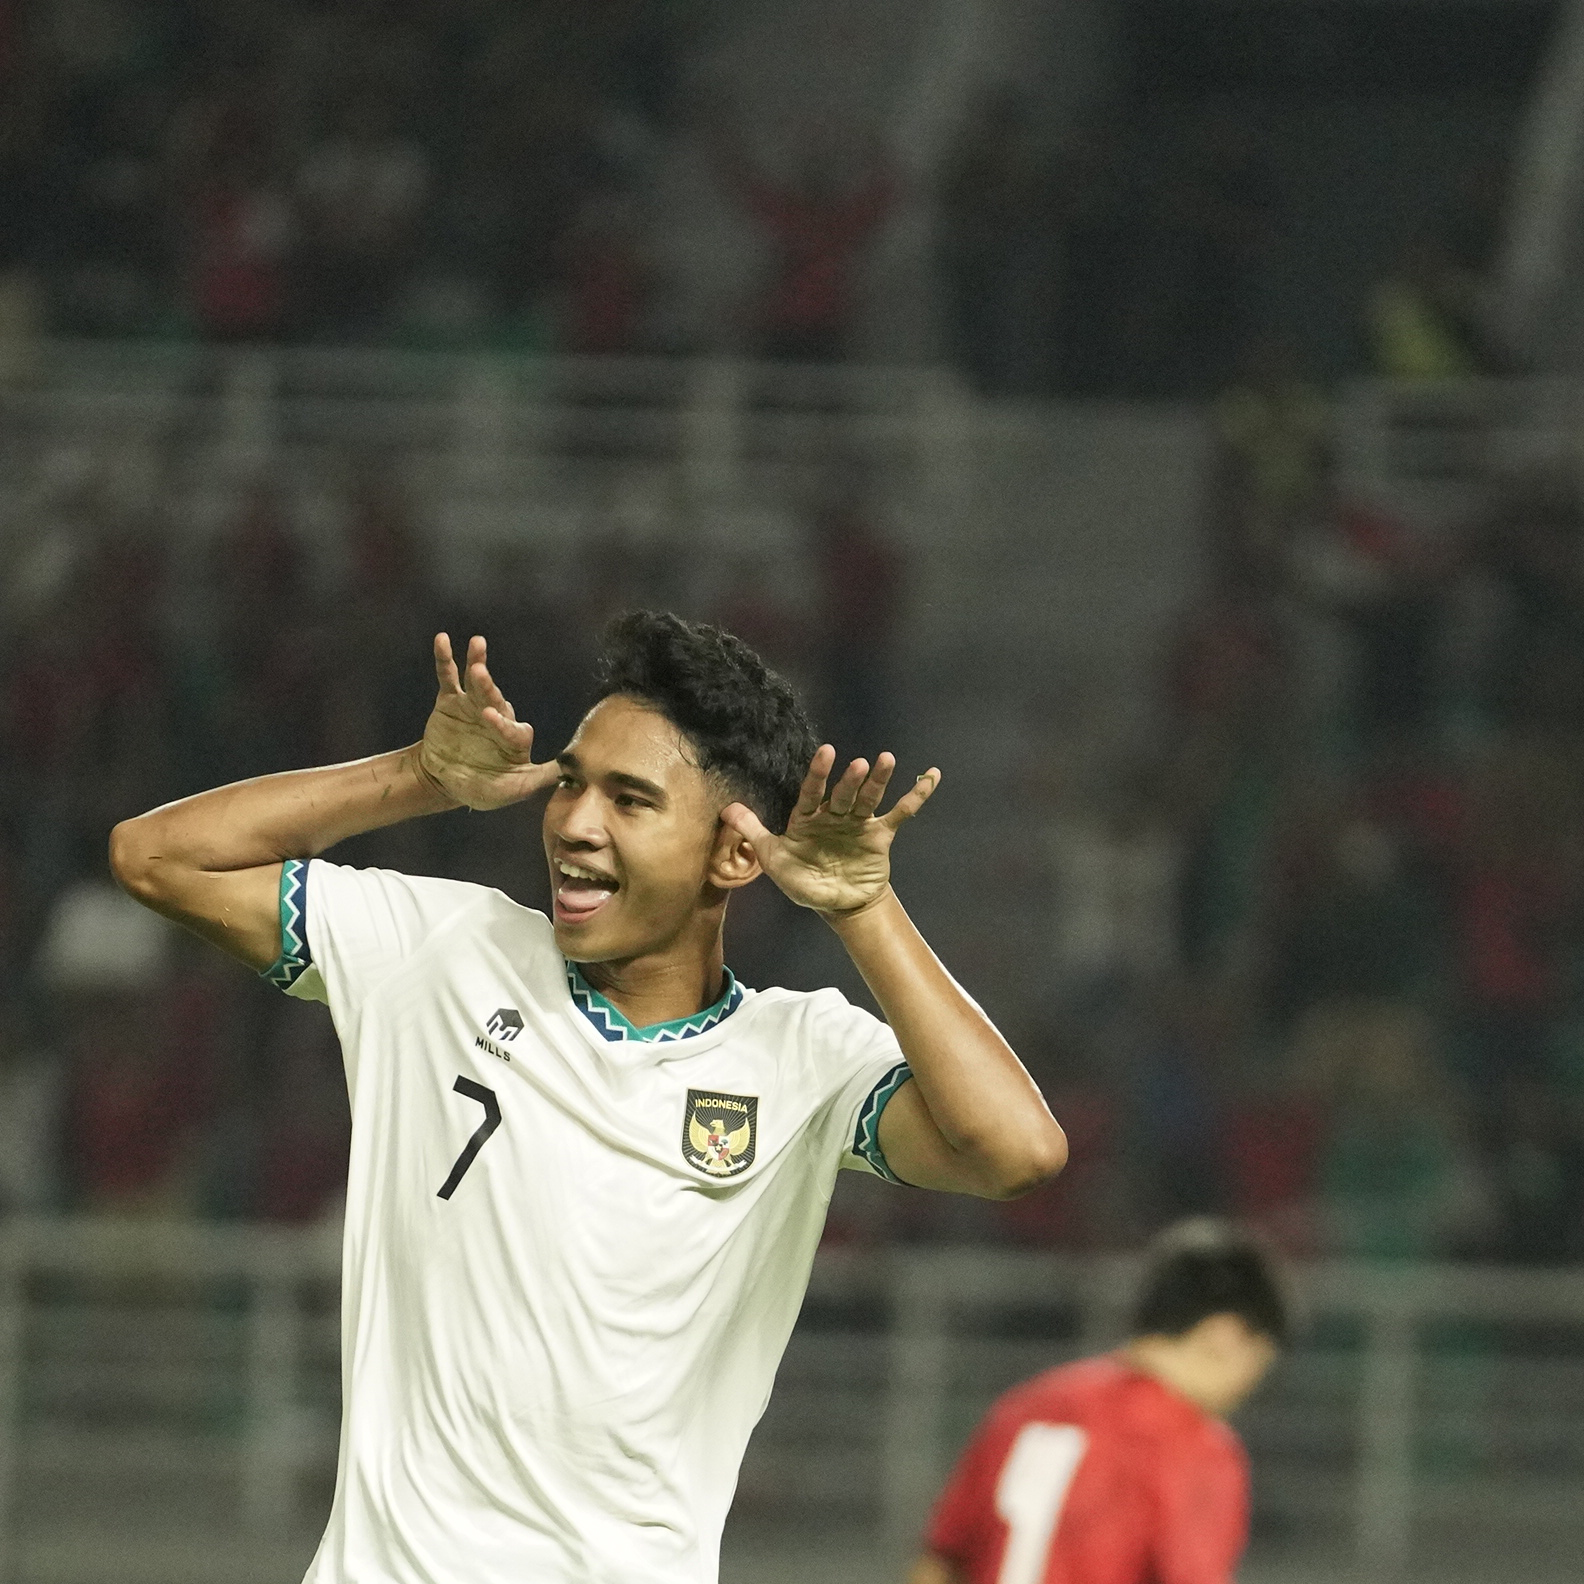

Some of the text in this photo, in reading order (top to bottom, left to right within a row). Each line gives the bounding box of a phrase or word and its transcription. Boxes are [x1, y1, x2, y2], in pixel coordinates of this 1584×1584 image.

[475, 1036, 511, 1062] MILLS
[694, 1098, 748, 1114] INDONESIA
[437, 1074, 503, 1201] 7
